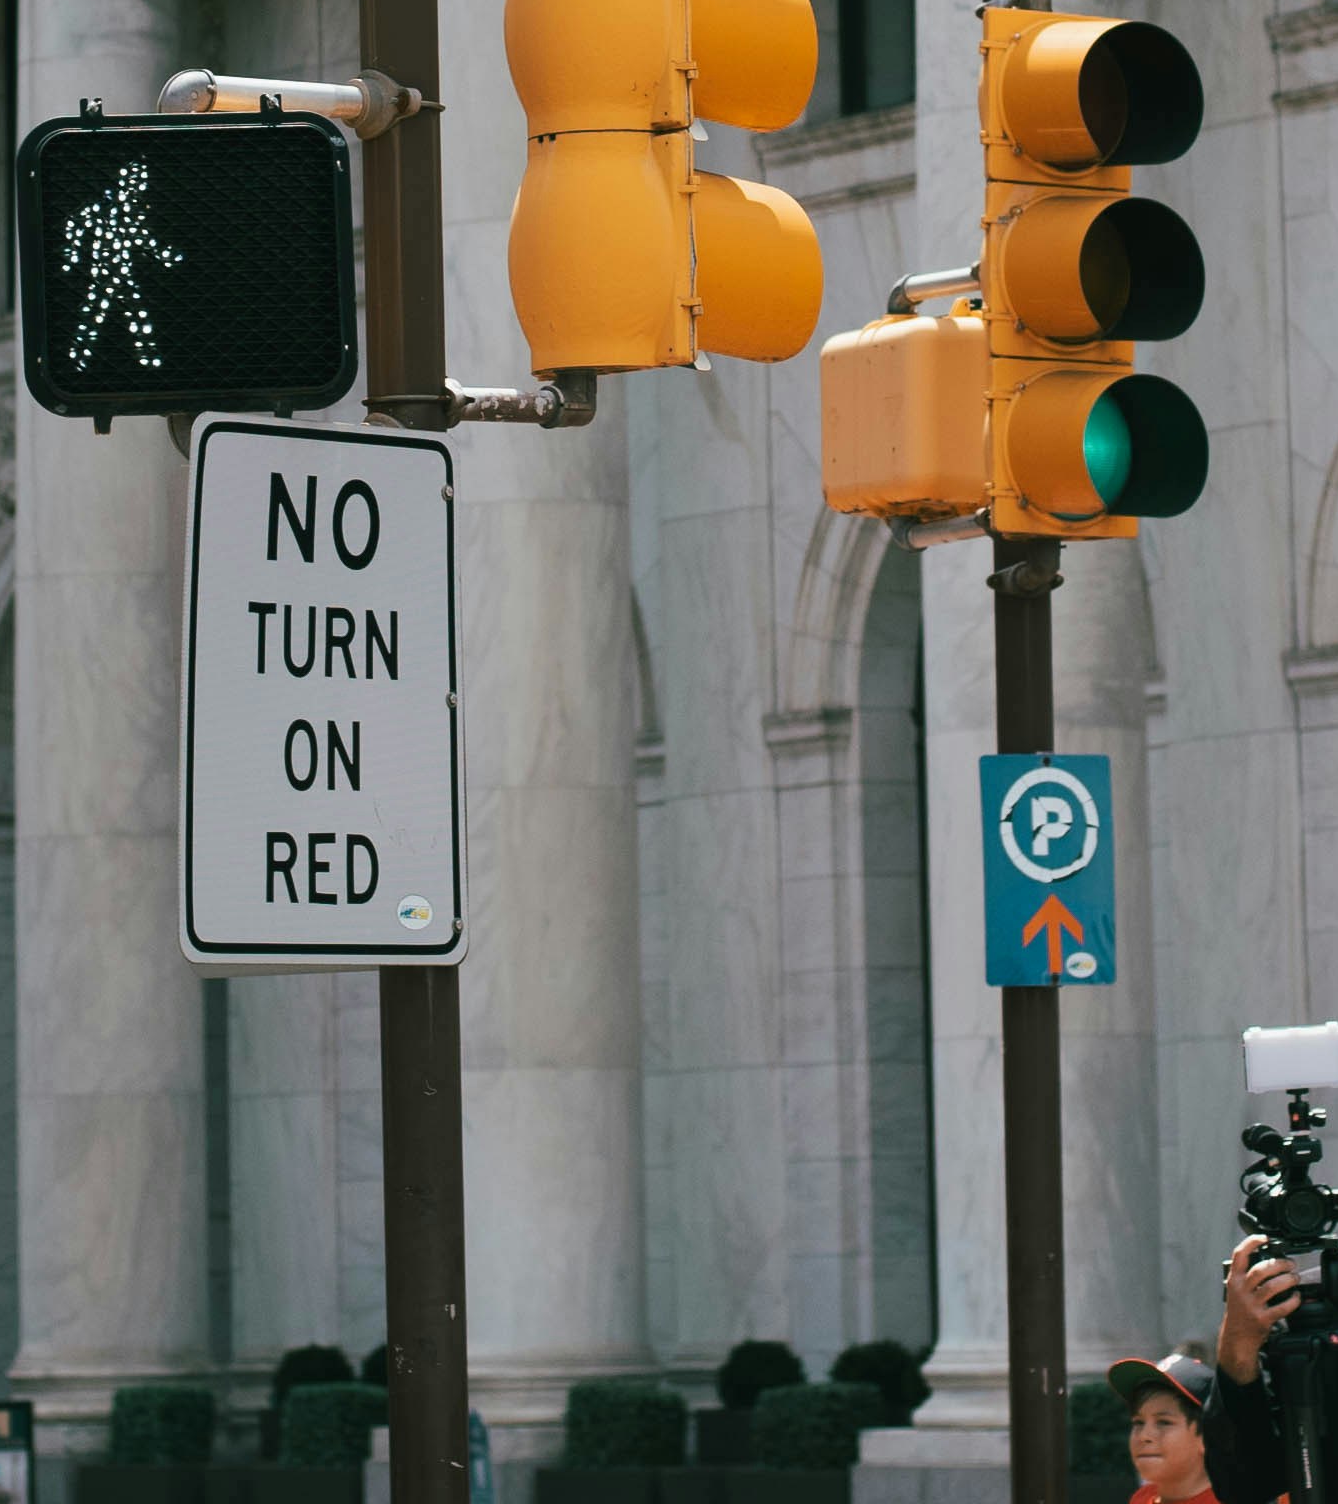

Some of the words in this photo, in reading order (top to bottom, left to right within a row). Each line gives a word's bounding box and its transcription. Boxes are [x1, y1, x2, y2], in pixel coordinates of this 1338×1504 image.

[266, 471, 381, 571] NO
[247, 600, 399, 682] TURN
[283, 718, 362, 792] ON
[1030, 796, 1074, 857] P
[265, 831, 380, 906] RED
